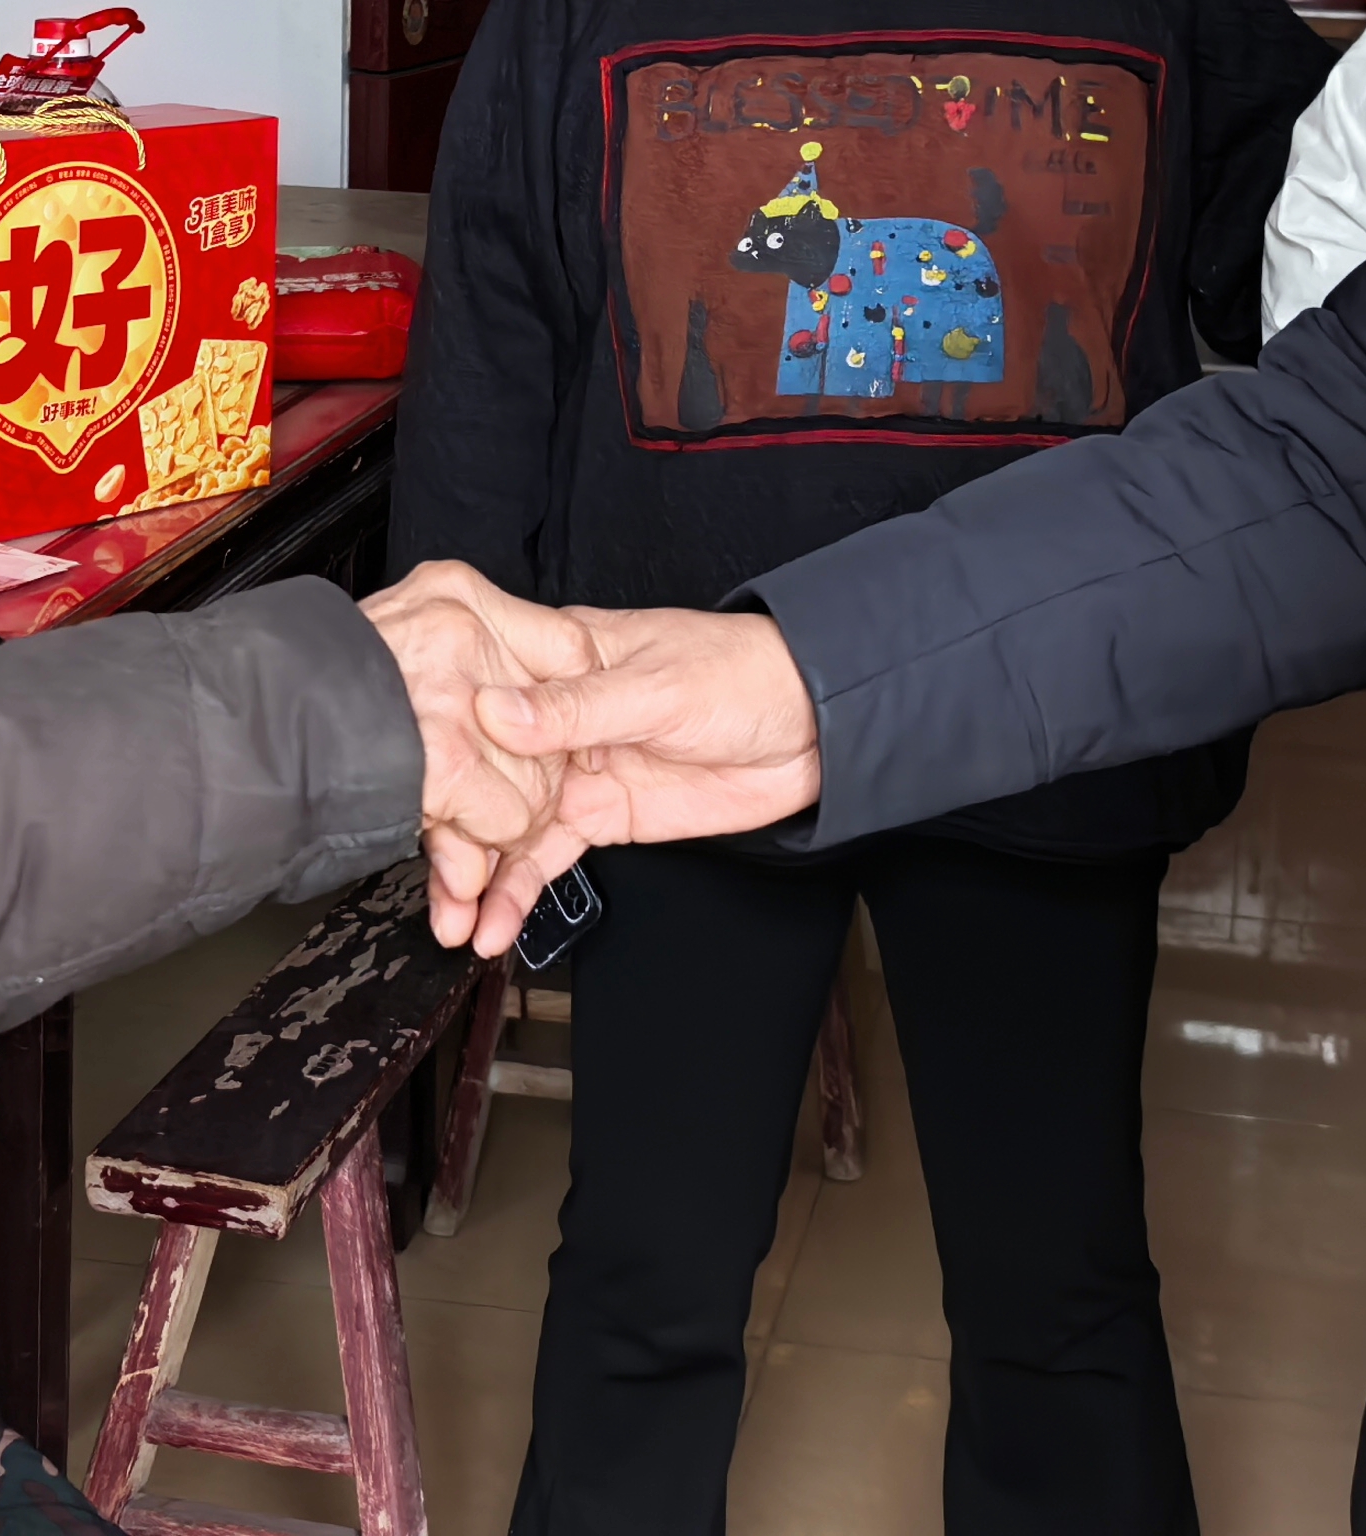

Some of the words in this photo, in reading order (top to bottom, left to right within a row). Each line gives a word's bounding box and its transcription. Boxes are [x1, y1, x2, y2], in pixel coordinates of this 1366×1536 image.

[185, 185, 258, 234] 3重美味
[200, 215, 247, 251] 1盒享
[40, 396, 99, 424] 好事来!
